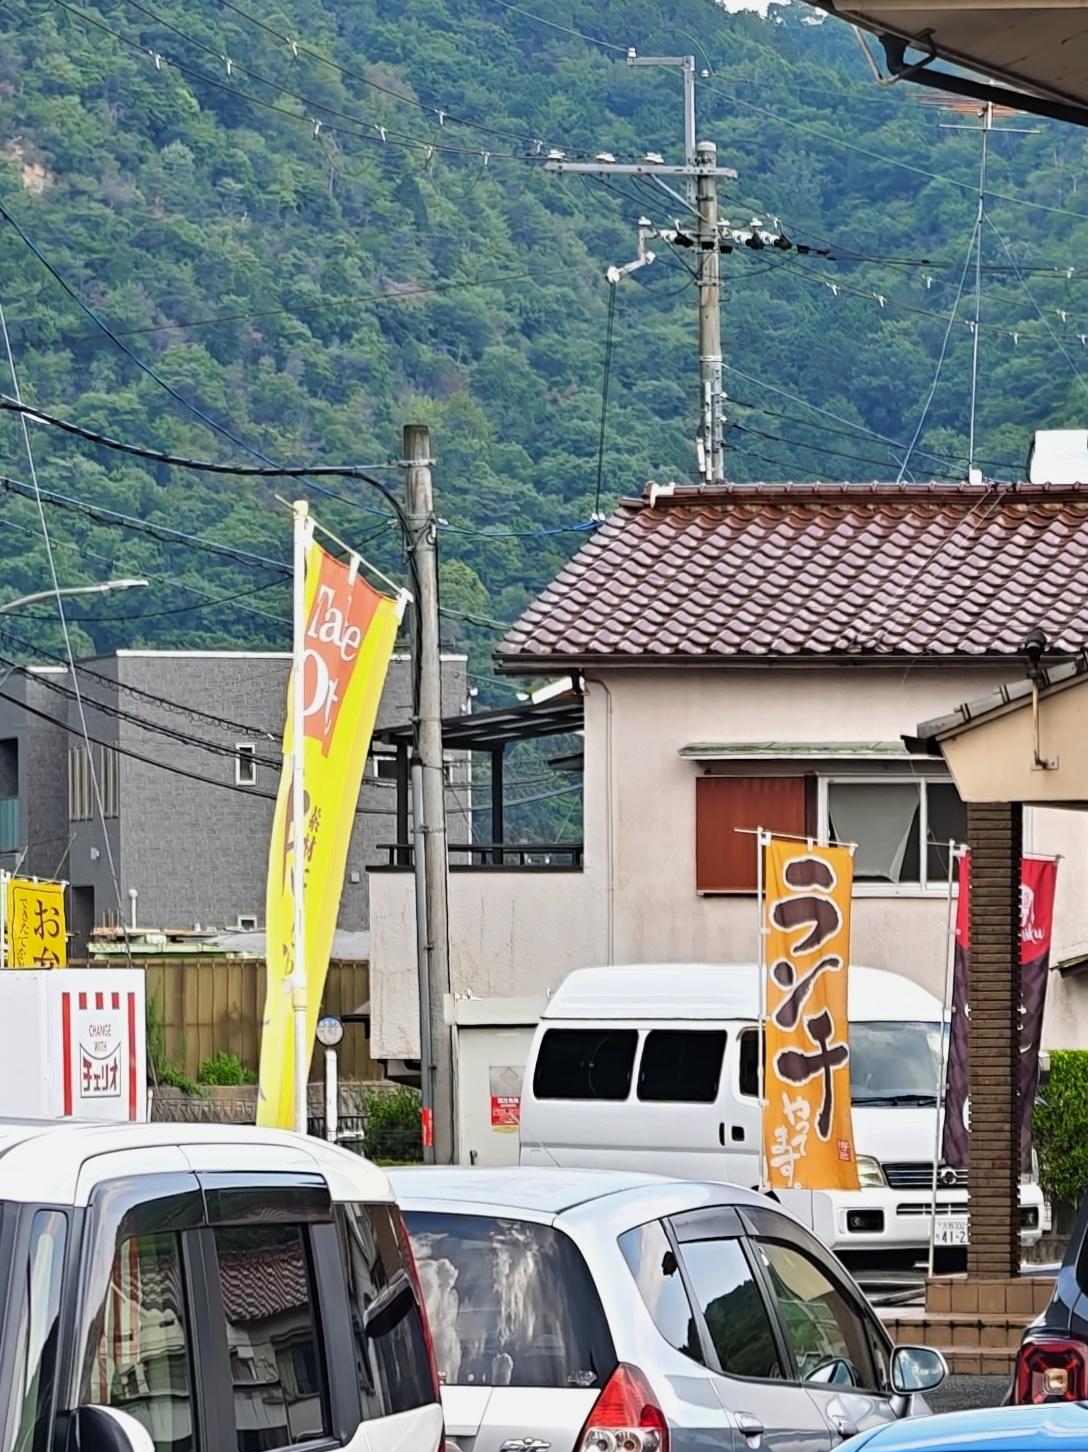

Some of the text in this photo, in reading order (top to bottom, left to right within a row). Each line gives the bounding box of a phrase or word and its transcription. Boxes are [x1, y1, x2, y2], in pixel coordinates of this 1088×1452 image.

[770, 855, 849, 1143] ランチ
[89, 1024, 111, 1037] CHANGE
[94, 1041, 107, 1052] WITH
[83, 1055, 118, 1091] チェリオ
[782, 1092, 811, 1156] やって
[942, 1230, 966, 1243] 41-2
